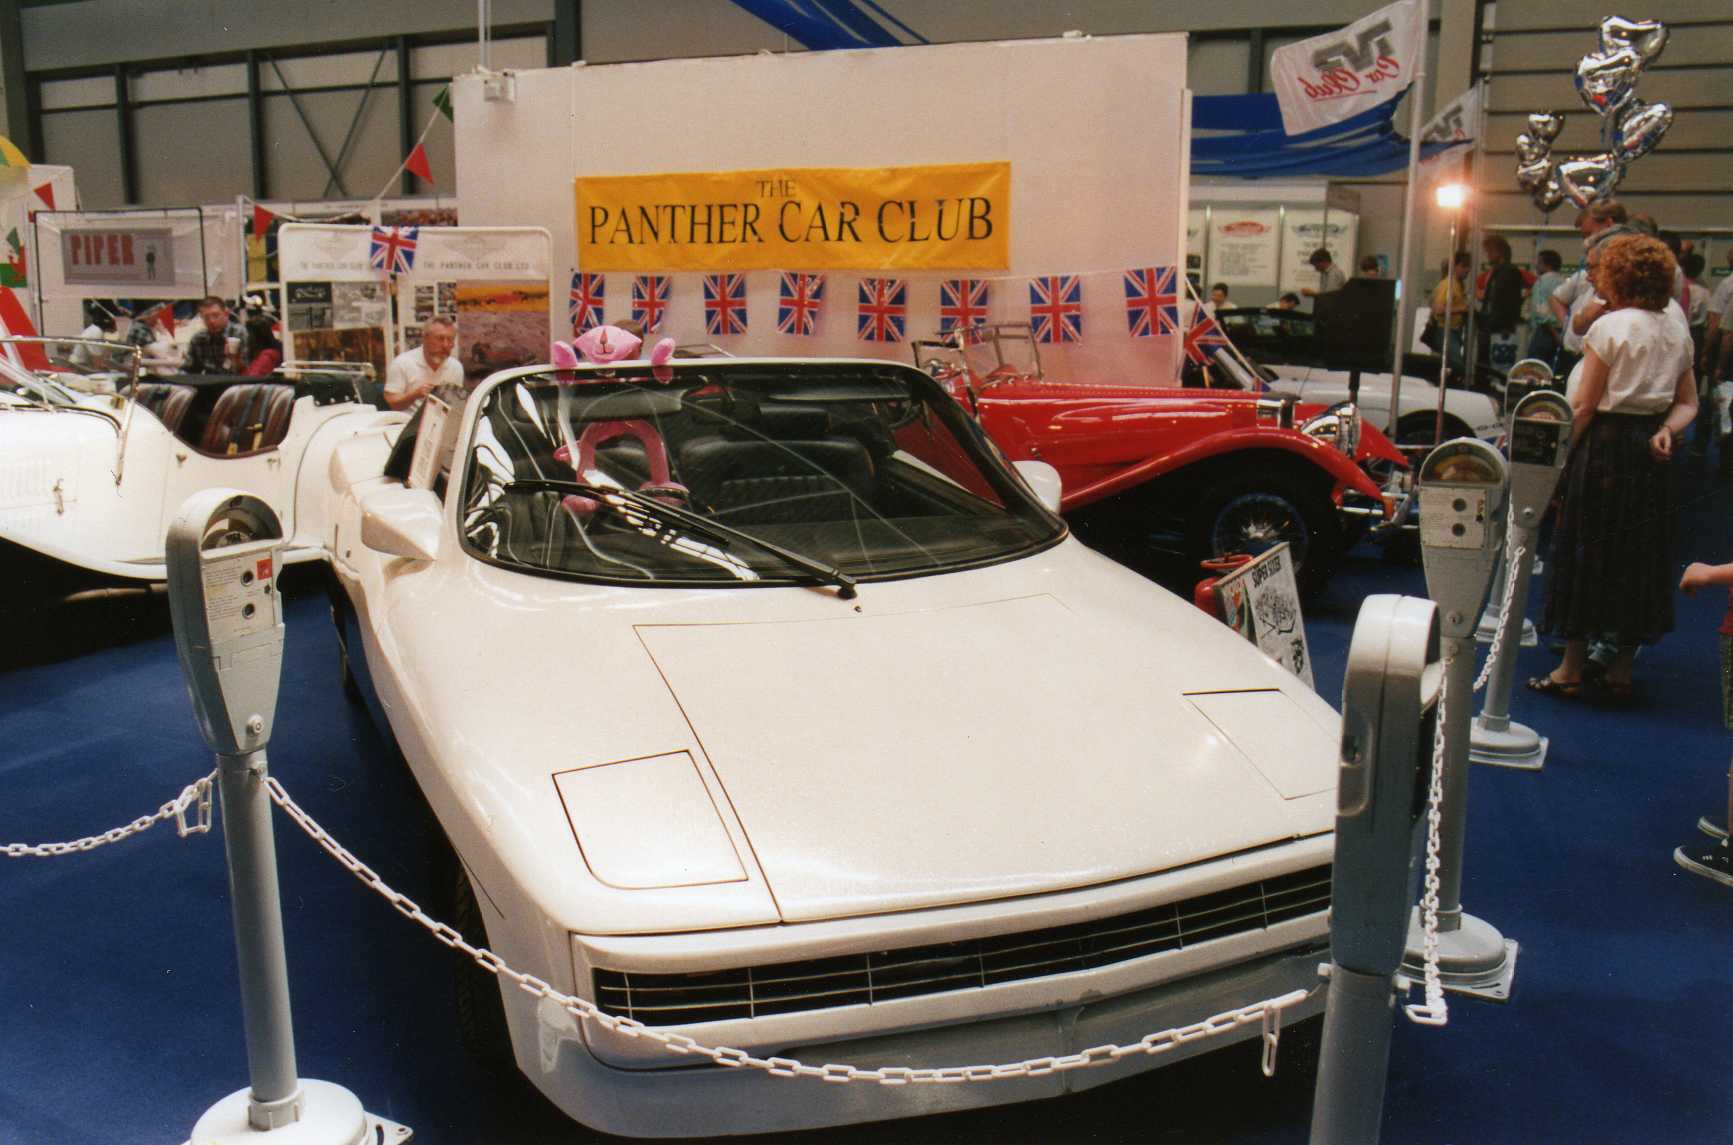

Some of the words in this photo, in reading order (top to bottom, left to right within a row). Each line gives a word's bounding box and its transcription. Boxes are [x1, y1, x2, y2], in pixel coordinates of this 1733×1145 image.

[755, 179, 796, 199] THE
[588, 202, 765, 245] PANTHER
[778, 200, 863, 244] CAR
[876, 196, 994, 244] CLUB
[70, 233, 135, 266] PIPER
